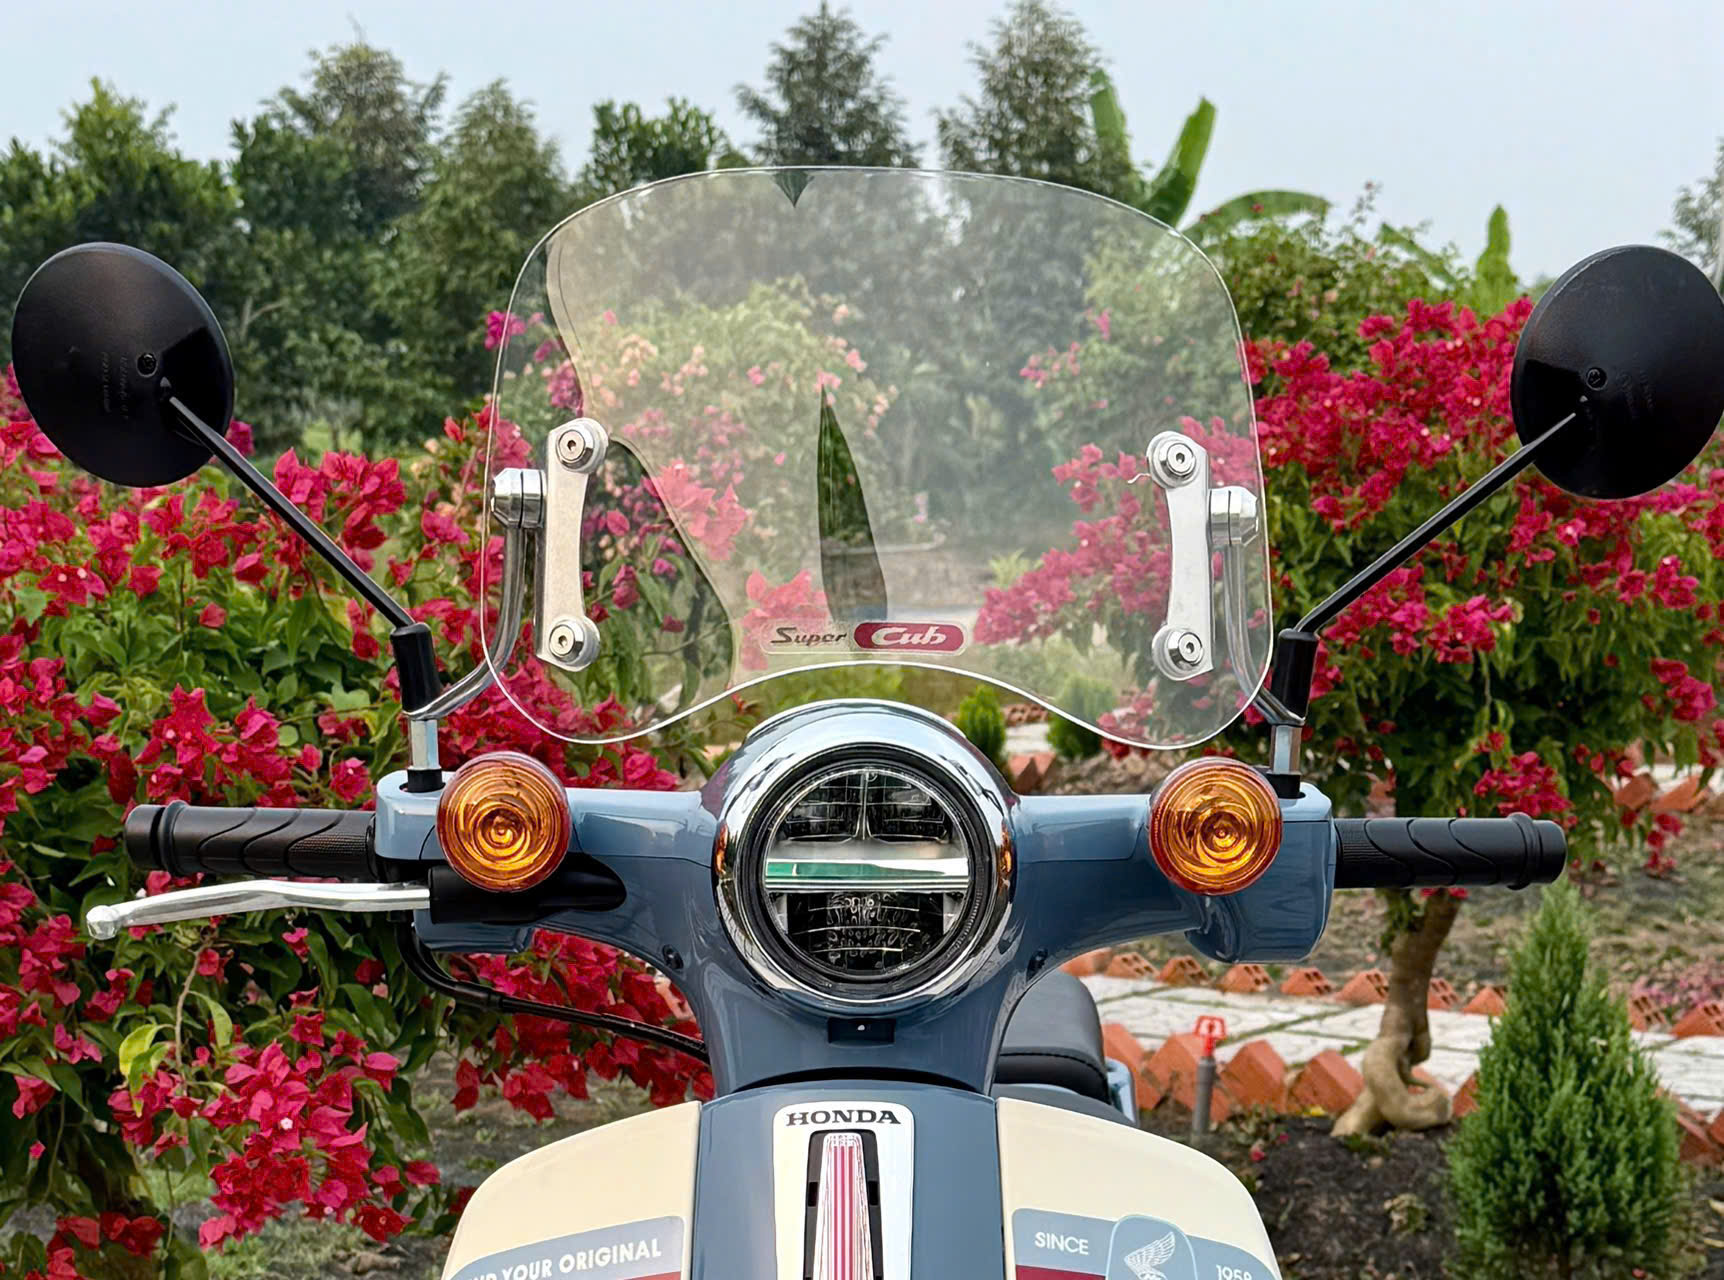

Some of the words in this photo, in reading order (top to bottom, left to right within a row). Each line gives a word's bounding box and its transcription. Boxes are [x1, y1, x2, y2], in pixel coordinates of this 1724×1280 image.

[770, 627, 847, 646] Super
[871, 625, 948, 646] Cub
[786, 1109, 902, 1126] HONDA
[1034, 1231, 1090, 1256] SINCE
[559, 1238, 662, 1273] ORIGINAL
